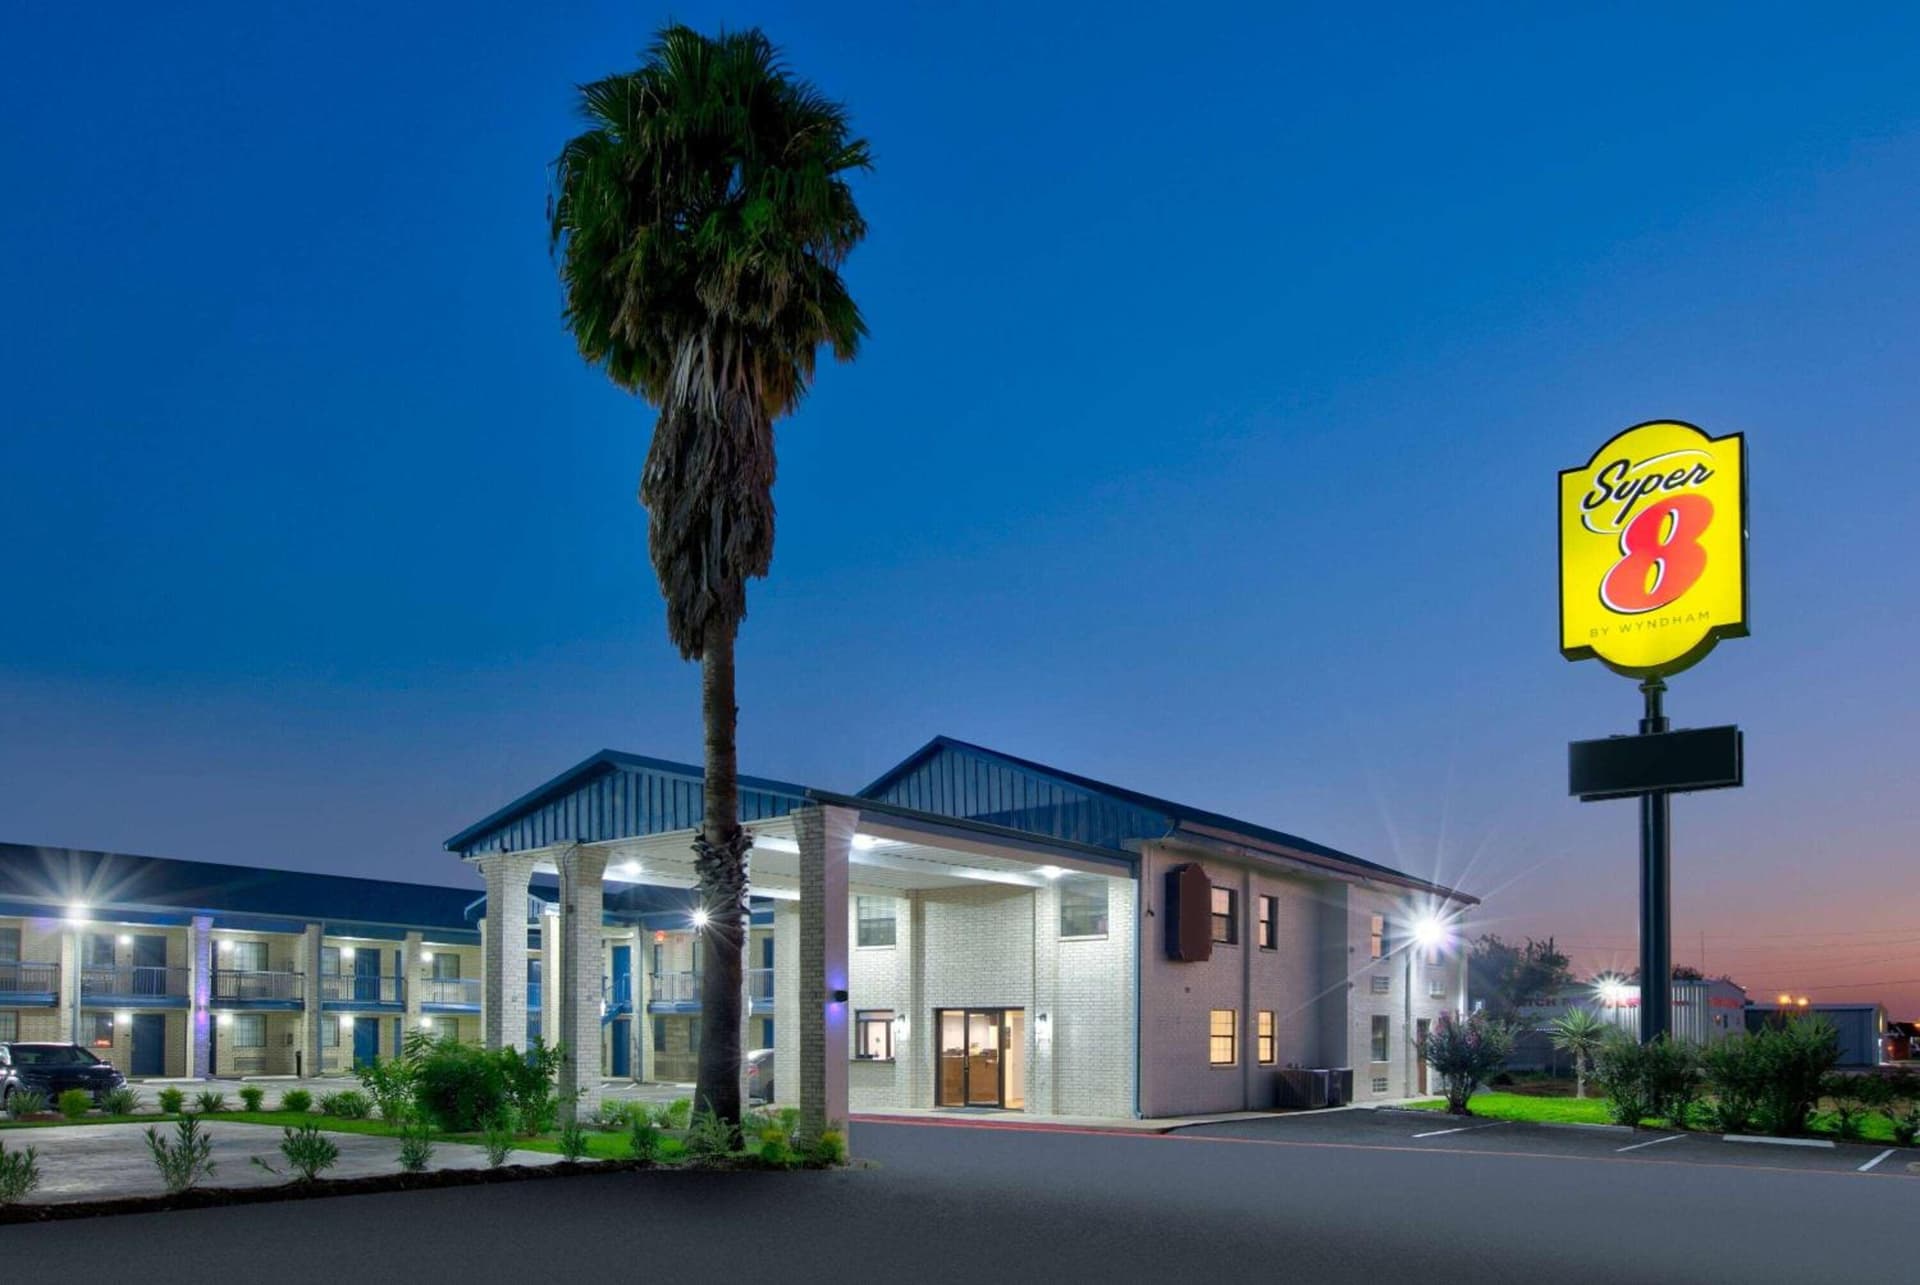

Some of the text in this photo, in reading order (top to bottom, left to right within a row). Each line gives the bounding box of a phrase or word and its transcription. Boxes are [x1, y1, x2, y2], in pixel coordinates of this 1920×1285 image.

[1582, 458, 1715, 526] Super
[1598, 494, 1714, 614] 8
[1589, 611, 1710, 638] BY WYNDHAM
